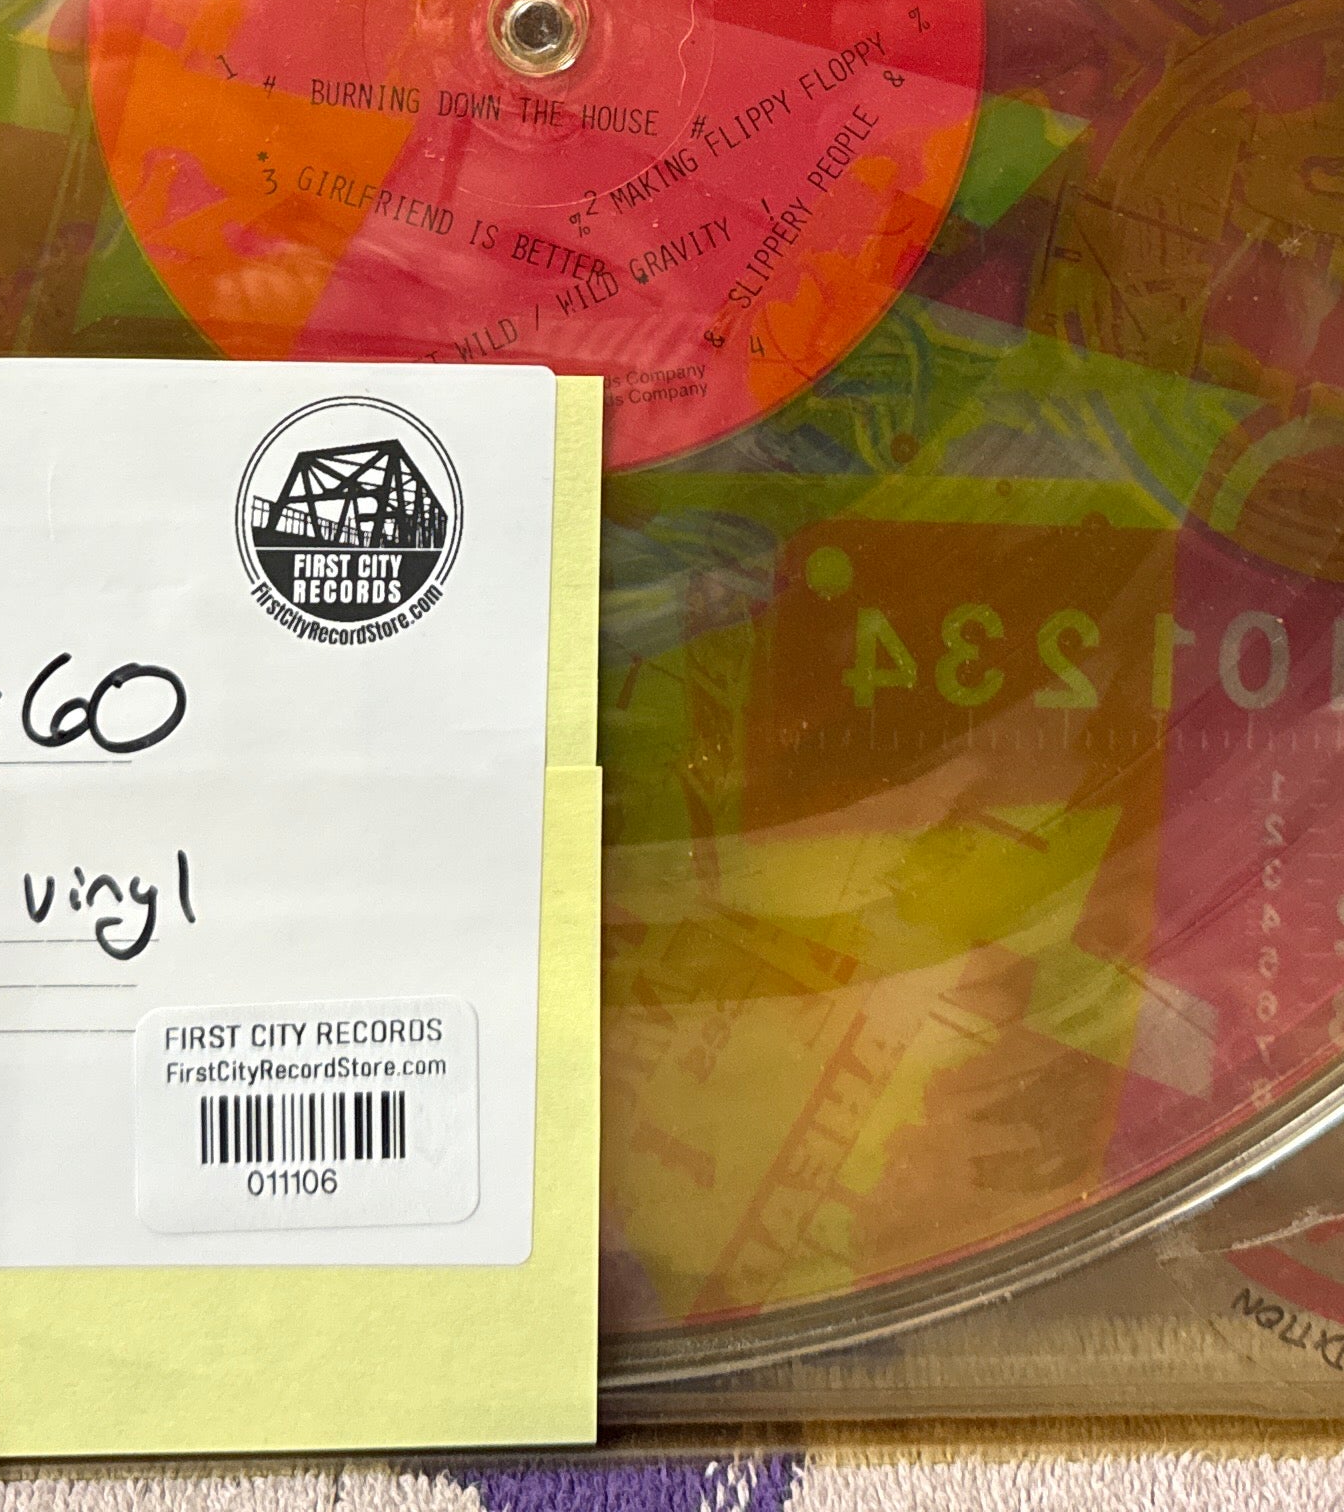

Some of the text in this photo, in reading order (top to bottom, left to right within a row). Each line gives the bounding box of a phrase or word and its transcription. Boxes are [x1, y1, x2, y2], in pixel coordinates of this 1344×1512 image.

[311, 78, 420, 115] BURNING
[437, 90, 502, 121] DOWN
[519, 97, 565, 127] THE
[582, 104, 659, 137] HOUSE
[610, 148, 699, 214] MAKING
[704, 89, 791, 157] FLIPPY
[799, 32, 888, 100] FLOPPY
[728, 196, 813, 309] SLIPPERY
[807, 105, 879, 192] PEOPLE
[298, 165, 454, 235] GIRLFRIEND
[470, 220, 499, 250] IS
[511, 233, 607, 282] BETTER
[454, 319, 519, 363] WILD
[556, 271, 619, 315] WILD
[629, 218, 731, 282] GRAVITY
[626, 365, 705, 385] Company
[629, 383, 707, 404] Company
[293, 554, 403, 578] FIRST CITY
[293, 579, 402, 604] RECORDS
[250, 581, 444, 646] FirstCityRecordStore.com
[164, 1018, 444, 1050] FIRST CITY RECORDS
[166, 1057, 447, 1086] FirstCityRecordStore.com
[247, 1168, 338, 1196] 011106
